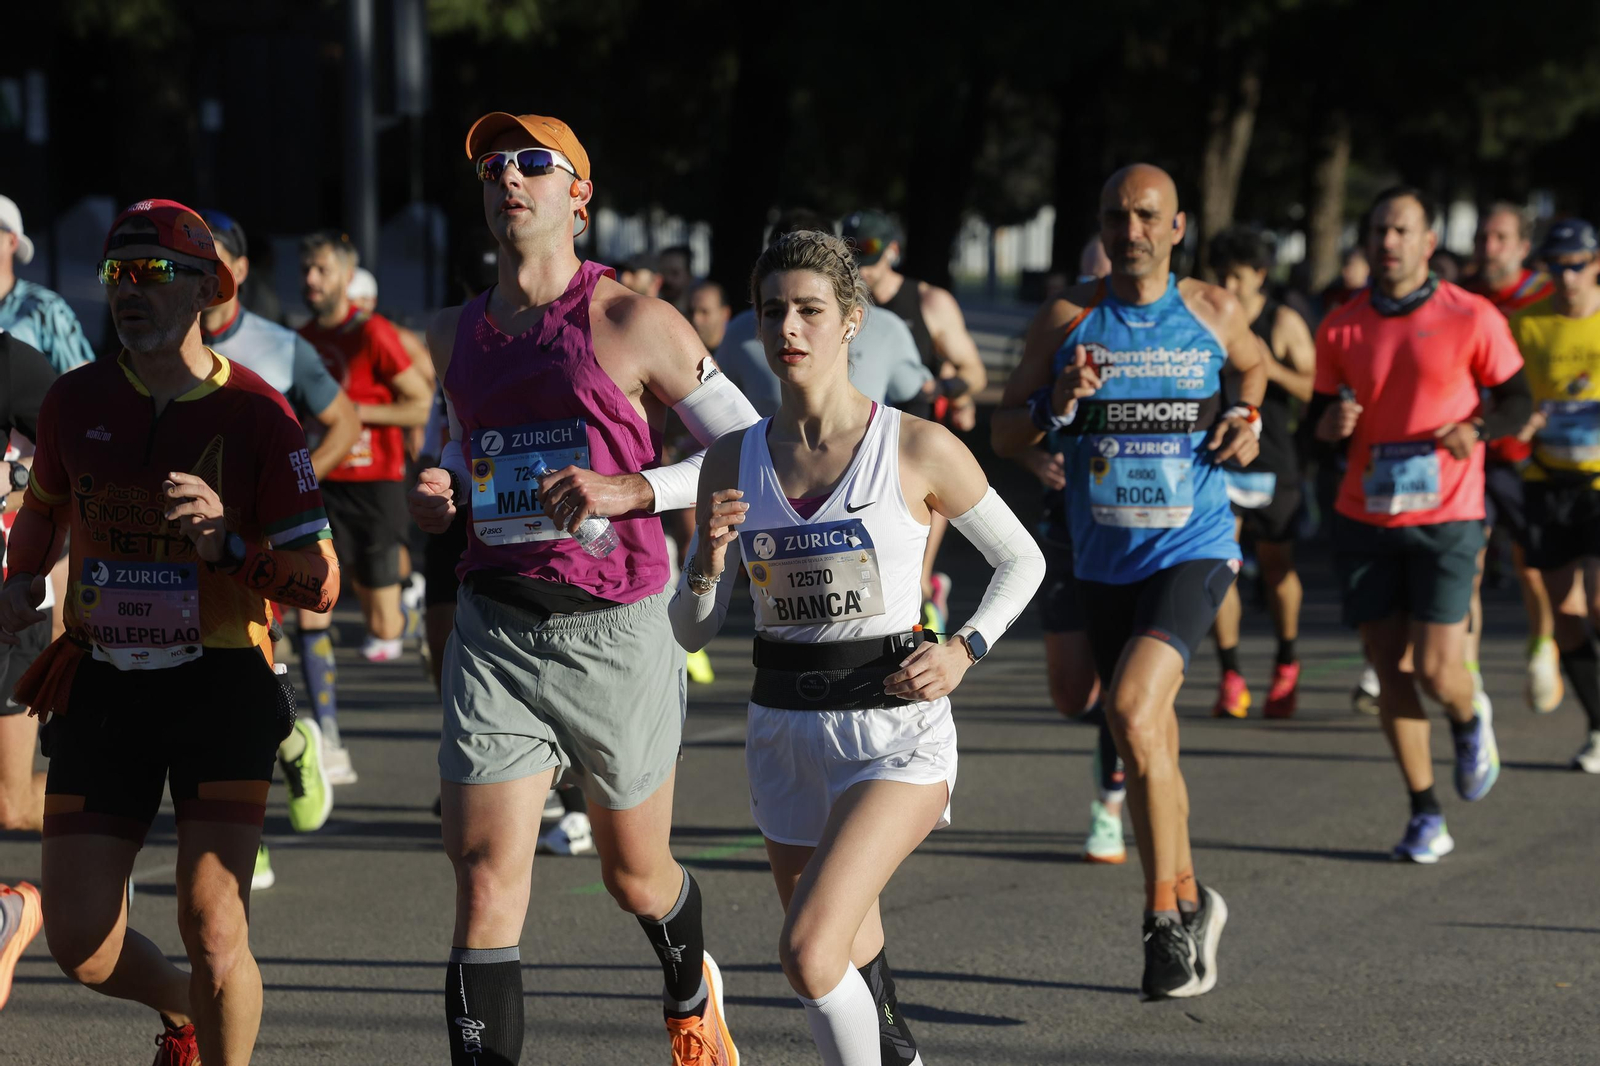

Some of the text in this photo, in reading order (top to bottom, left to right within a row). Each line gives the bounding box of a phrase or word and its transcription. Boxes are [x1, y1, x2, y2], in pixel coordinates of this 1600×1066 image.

[1092, 346, 1212, 365] themidnight
[1100, 364, 1204, 382] predators
[1107, 403, 1200, 422] BEMORE
[511, 428, 573, 448] ZURICH
[1124, 442, 1181, 455] ZURICH
[514, 466, 536, 482] 72
[106, 483, 148, 501] Pasito
[1116, 487, 1167, 504] ROCA
[92, 526, 178, 556] de RETT
[784, 528, 859, 551] ZURICH
[115, 569, 182, 584] ZURICH
[787, 568, 834, 588] 12570
[118, 602, 152, 617] 8067
[775, 590, 862, 621] BIANCA
